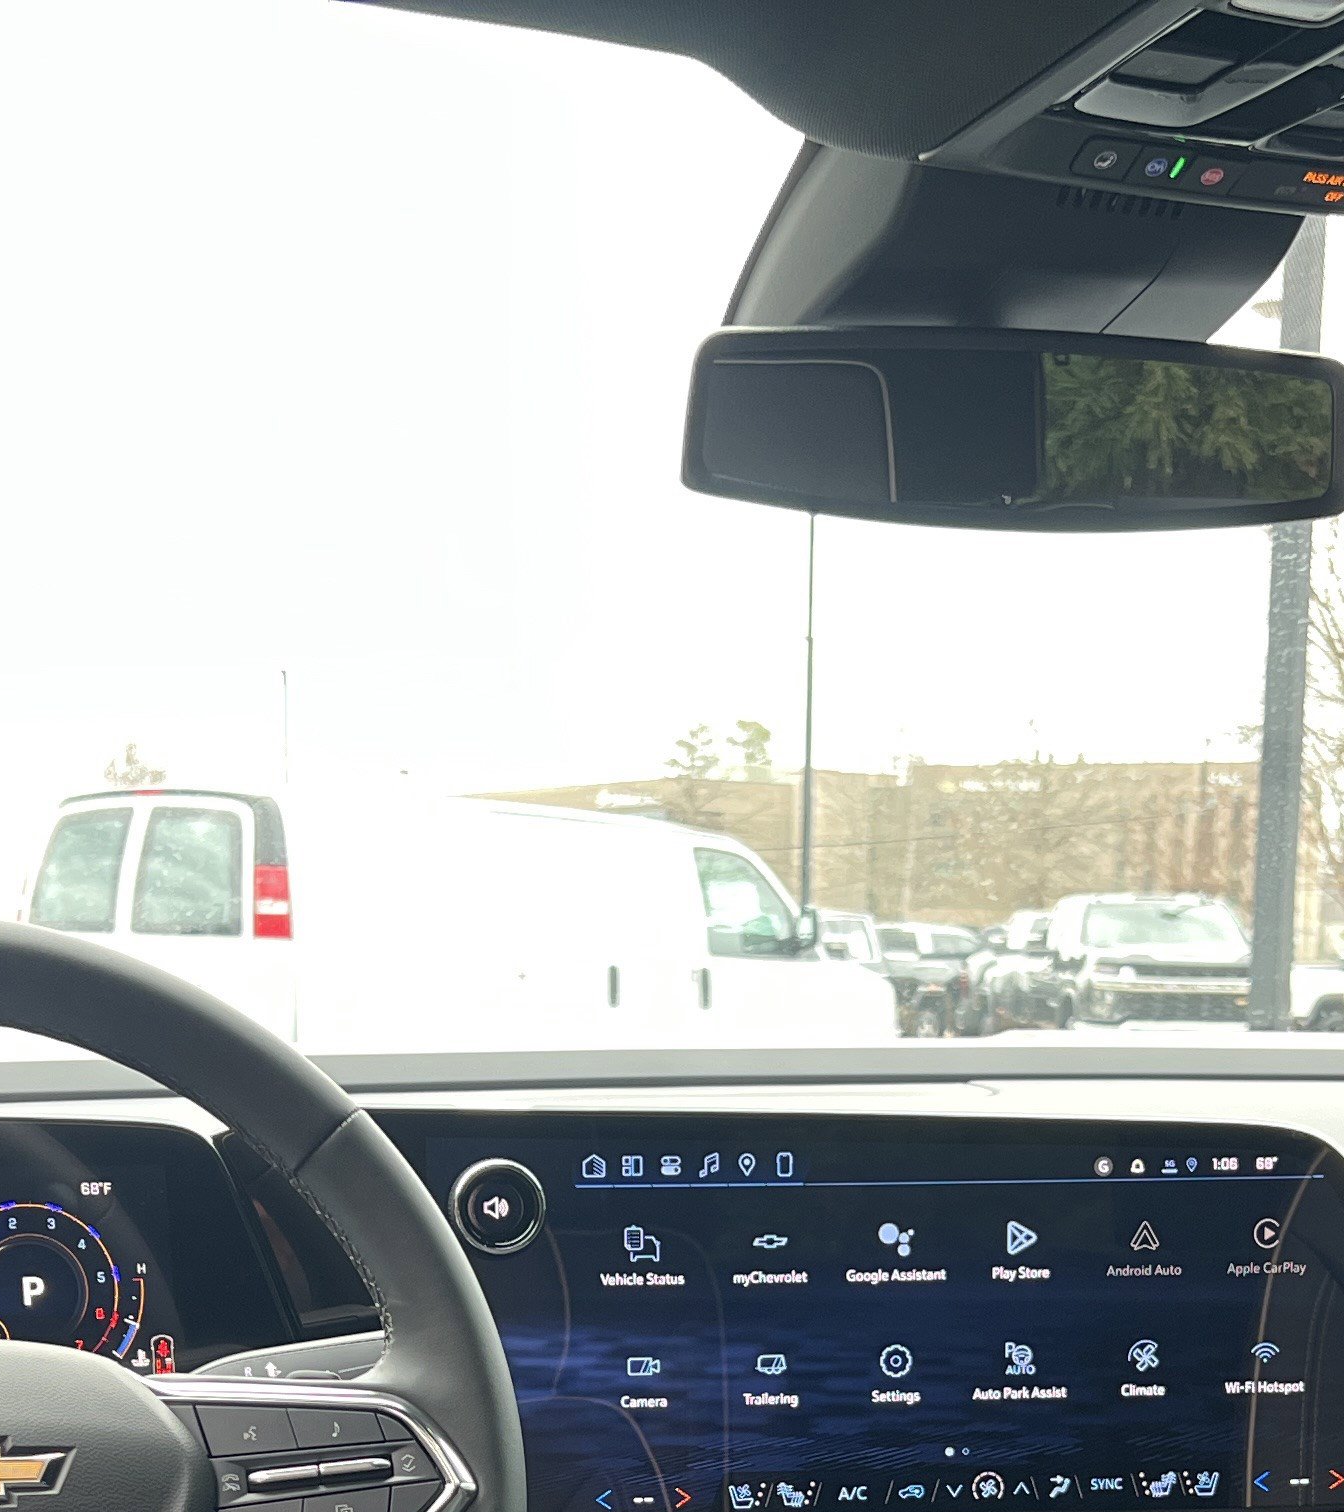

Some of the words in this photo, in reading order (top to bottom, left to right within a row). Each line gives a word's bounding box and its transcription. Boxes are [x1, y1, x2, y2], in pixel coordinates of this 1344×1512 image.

[1212, 1157, 1239, 1171] 1:06
[8, 1217, 18, 1230] 2
[47, 1217, 56, 1230] 3
[76, 1238, 87, 1250] 4
[136, 1262, 147, 1274] H
[992, 1266, 1017, 1282] Play
[1019, 1265, 1050, 1281] Store
[1106, 1263, 1151, 1277] Android
[1154, 1262, 1182, 1276] Auto
[1227, 1261, 1260, 1277] Apple
[1263, 1261, 1306, 1276] CarPlay
[96, 1271, 106, 1283] 5
[600, 1273, 643, 1287] Vehicle
[646, 1272, 685, 1286] Status
[732, 1270, 808, 1285] myChevrolet
[846, 1269, 889, 1284] Google
[891, 1268, 946, 1282] Assistant
[21, 1275, 46, 1307] P
[1005, 1364, 1036, 1375] AUTO
[972, 1387, 1001, 1400] Auto
[1004, 1386, 1028, 1399] Park
[1031, 1385, 1067, 1398] Assist
[1121, 1383, 1165, 1397] Climate
[1224, 1380, 1255, 1394] Wi-Fi
[1258, 1379, 1305, 1395] Hotspot
[620, 1395, 668, 1408] Camera
[743, 1392, 799, 1407] Trailering
[871, 1389, 921, 1405] Settings
[1090, 1477, 1123, 1490] SYNC
[838, 1485, 868, 1501] A/C
